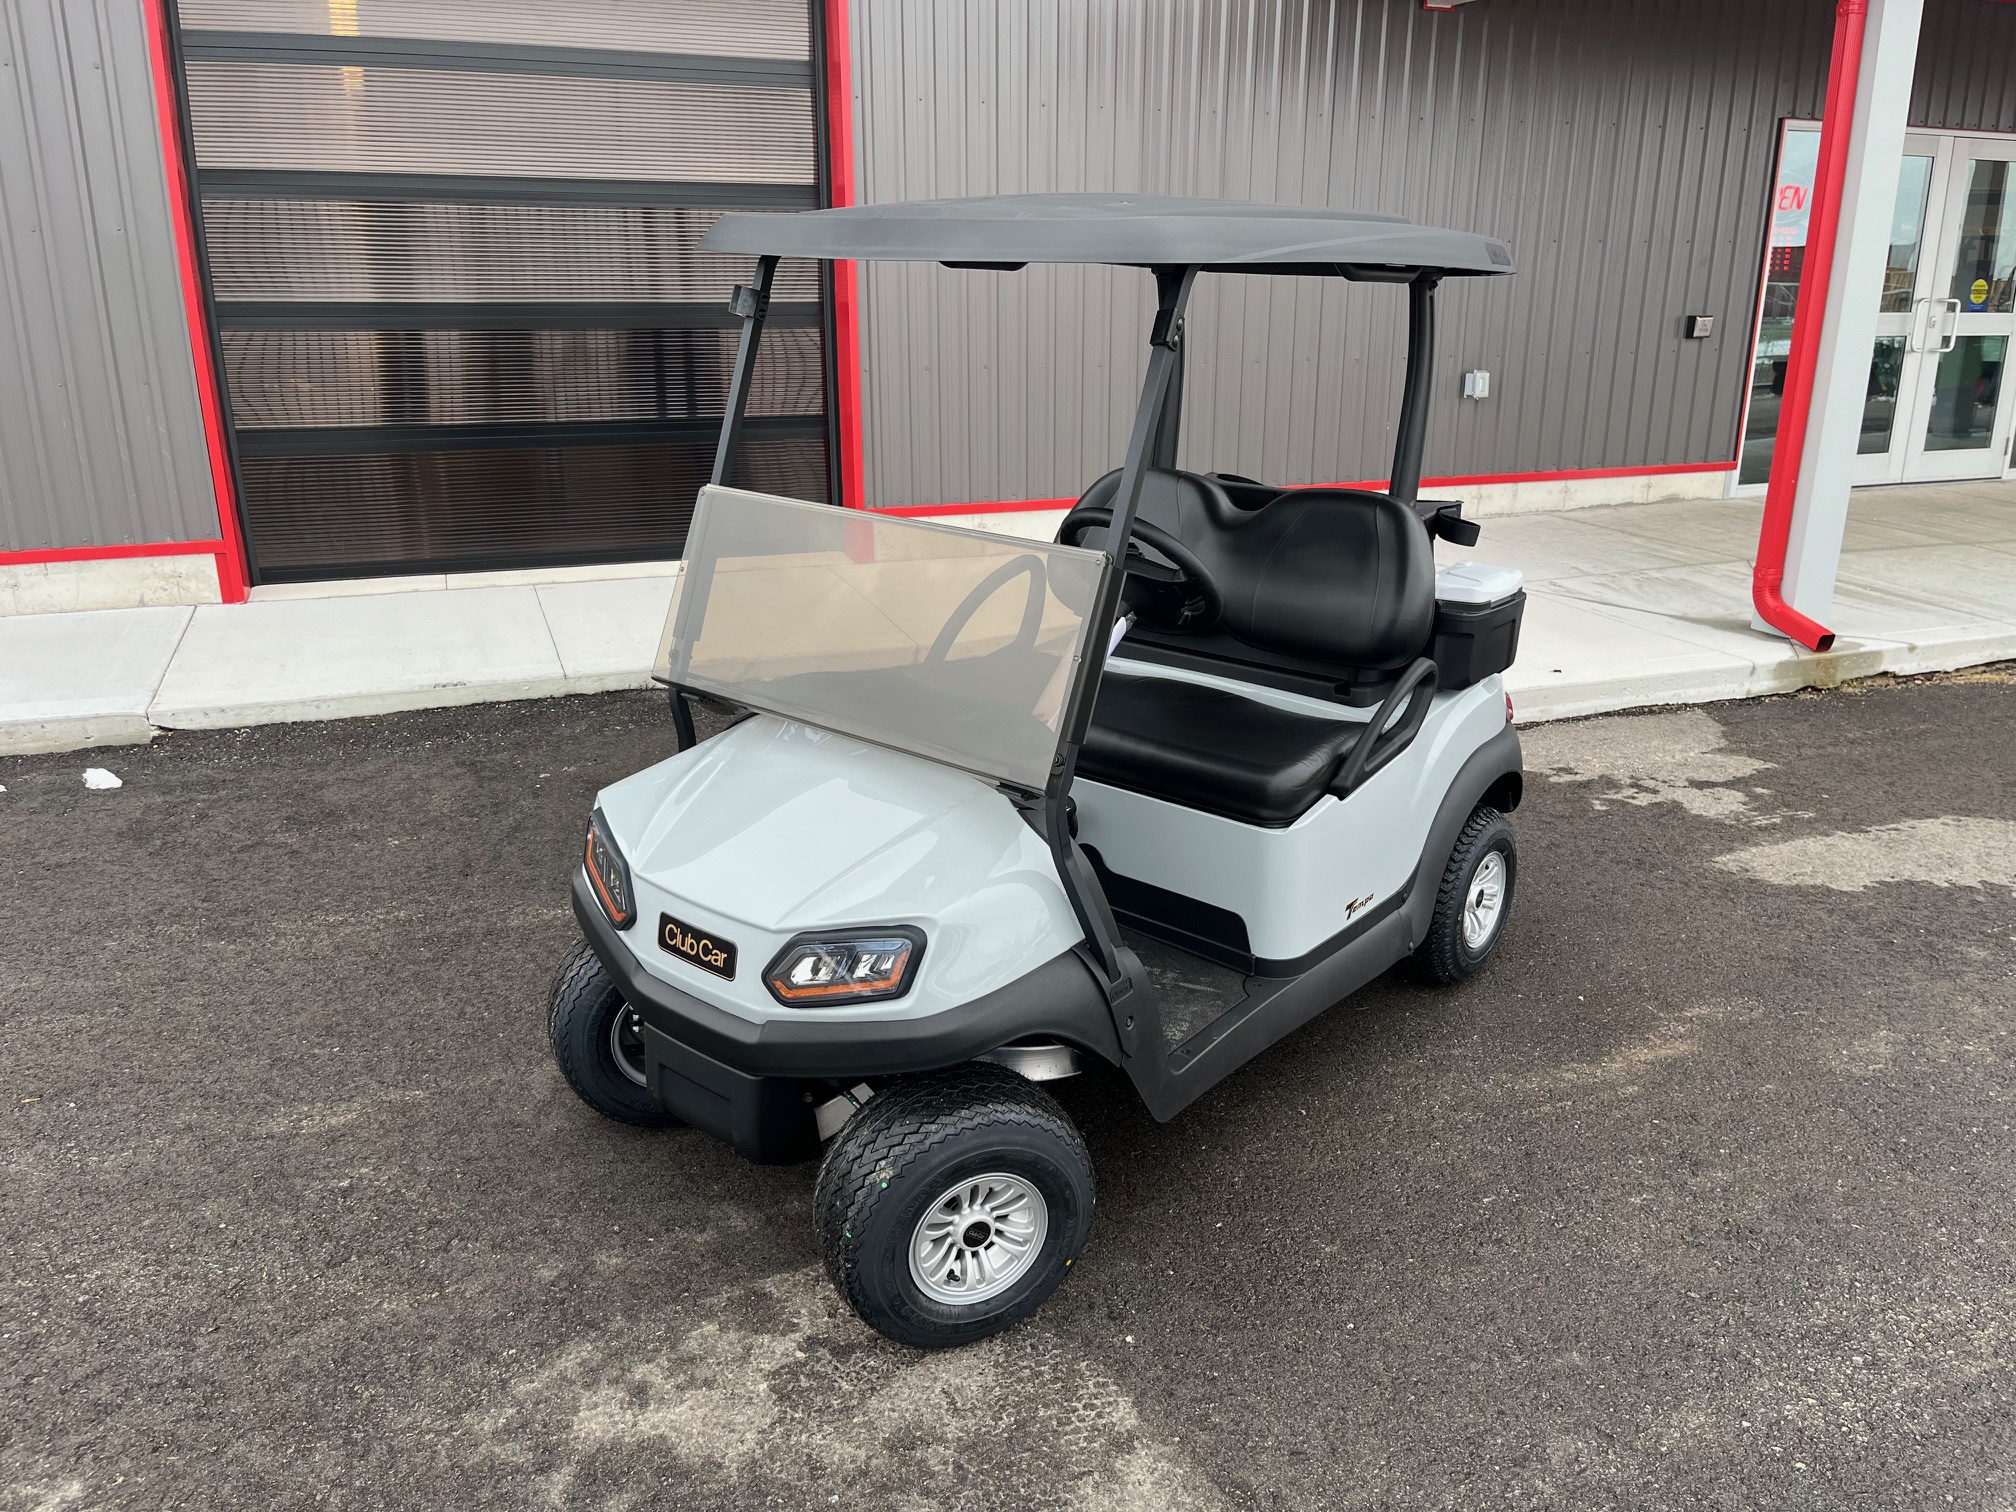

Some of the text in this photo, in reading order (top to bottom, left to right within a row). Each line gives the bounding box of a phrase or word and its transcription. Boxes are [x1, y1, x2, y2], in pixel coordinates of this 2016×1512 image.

[1778, 184, 1808, 211] EN
[665, 923, 727, 967] Club Car
